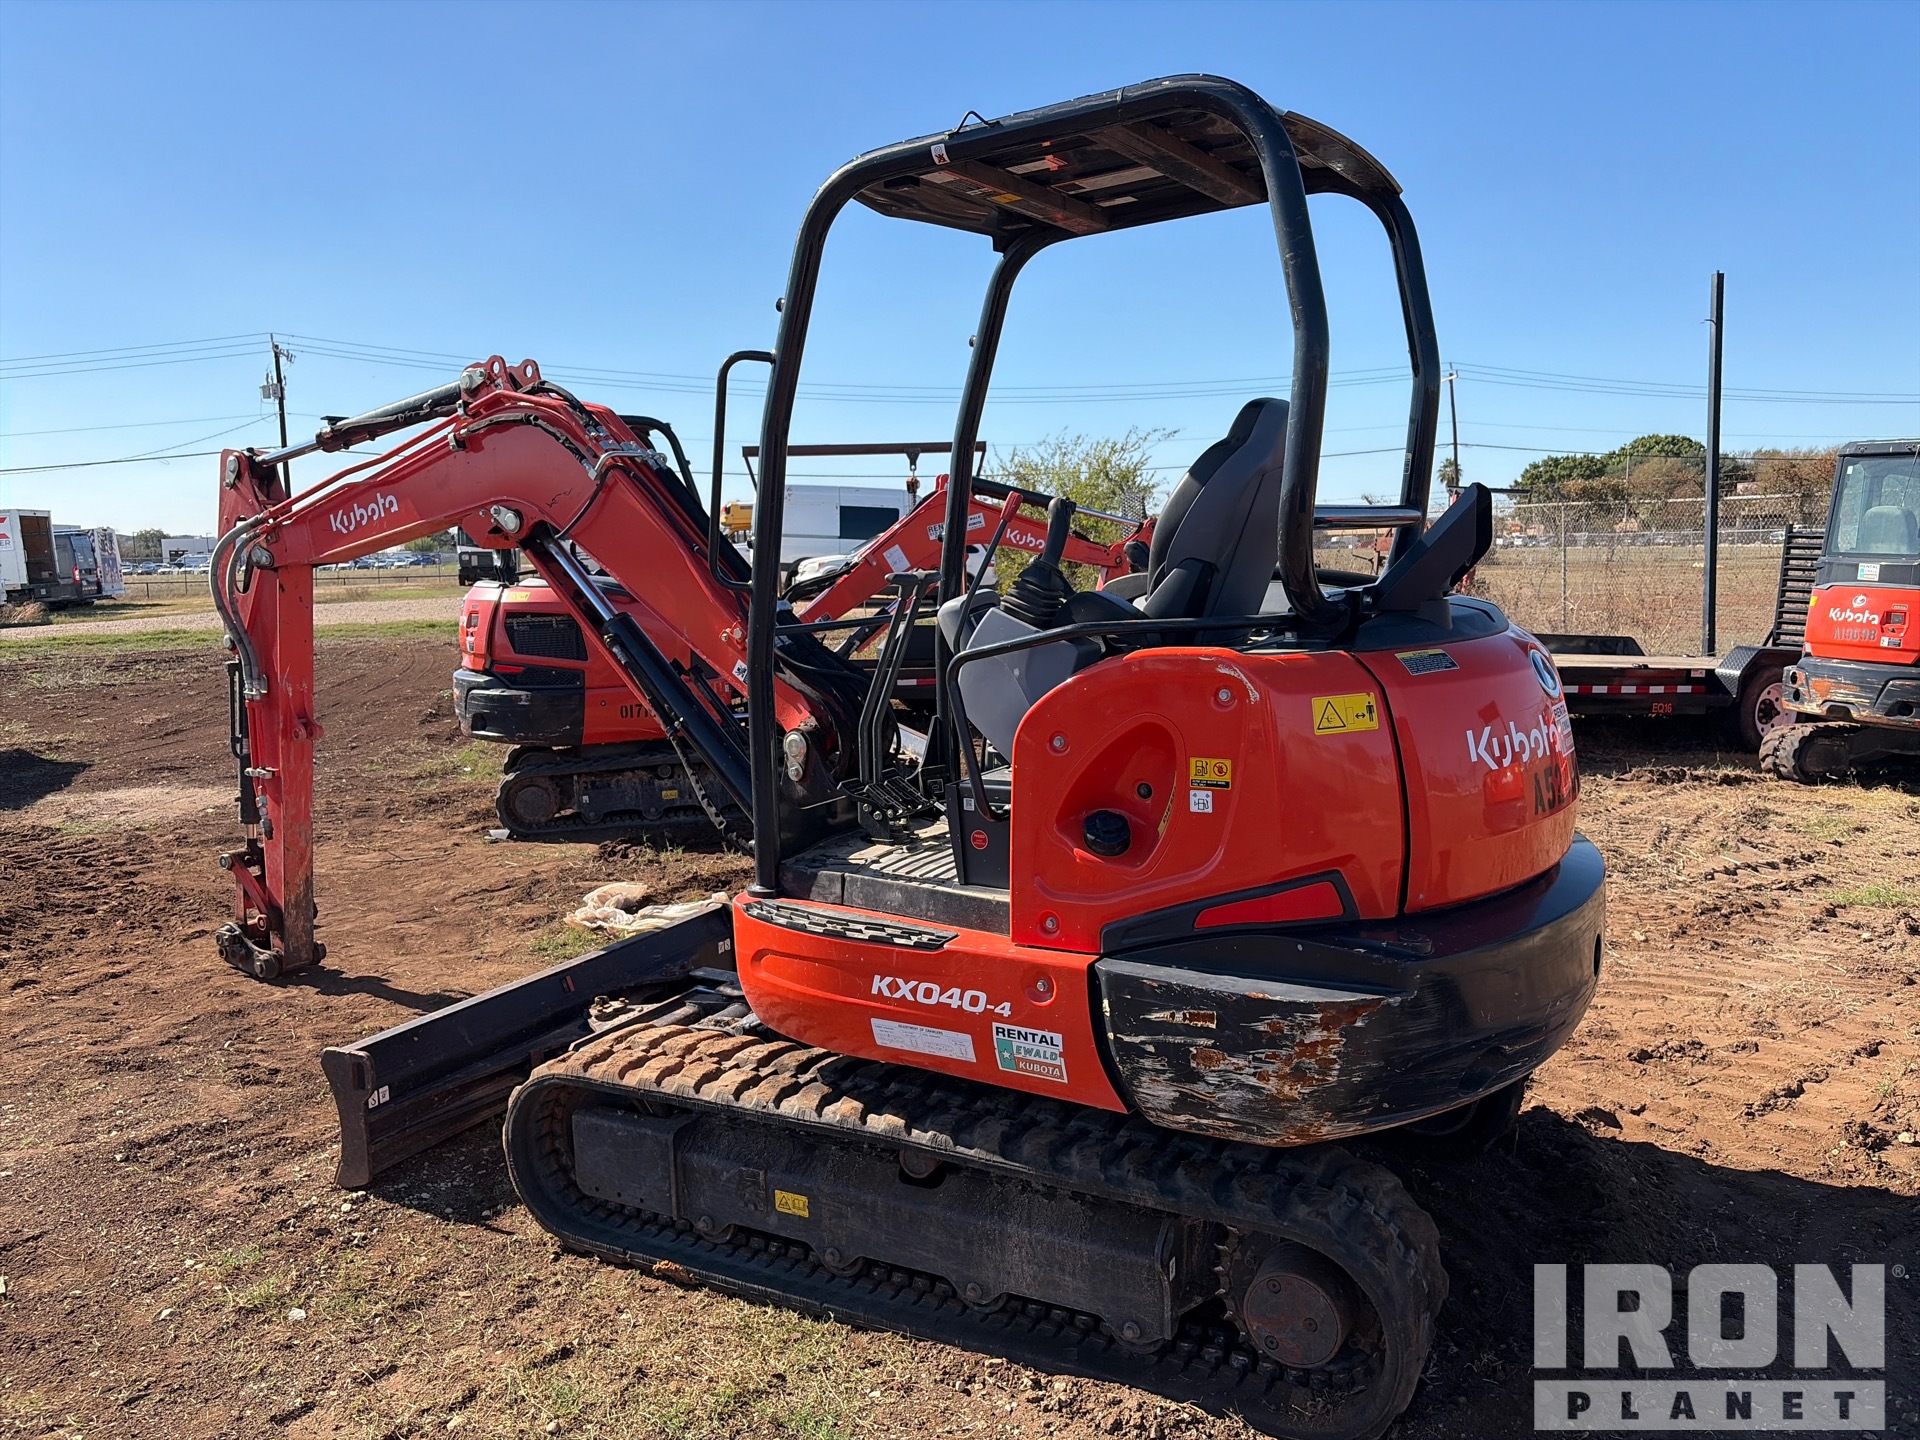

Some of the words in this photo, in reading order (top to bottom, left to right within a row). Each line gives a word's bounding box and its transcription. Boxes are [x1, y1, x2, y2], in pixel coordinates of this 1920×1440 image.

[329, 492, 399, 534] Kubota
[928, 523, 945, 533] REN
[1006, 528, 1046, 549] Kubo
[1829, 607, 1879, 625] Kubota
[1652, 703, 1672, 713] EQ16
[1466, 714, 1561, 771] Kubota
[871, 974, 1012, 1017] KX040-4
[995, 1026, 1060, 1047] RENTAL
[1015, 1045, 1058, 1062] EWALD
[1019, 1061, 1061, 1076] KUBOTA
